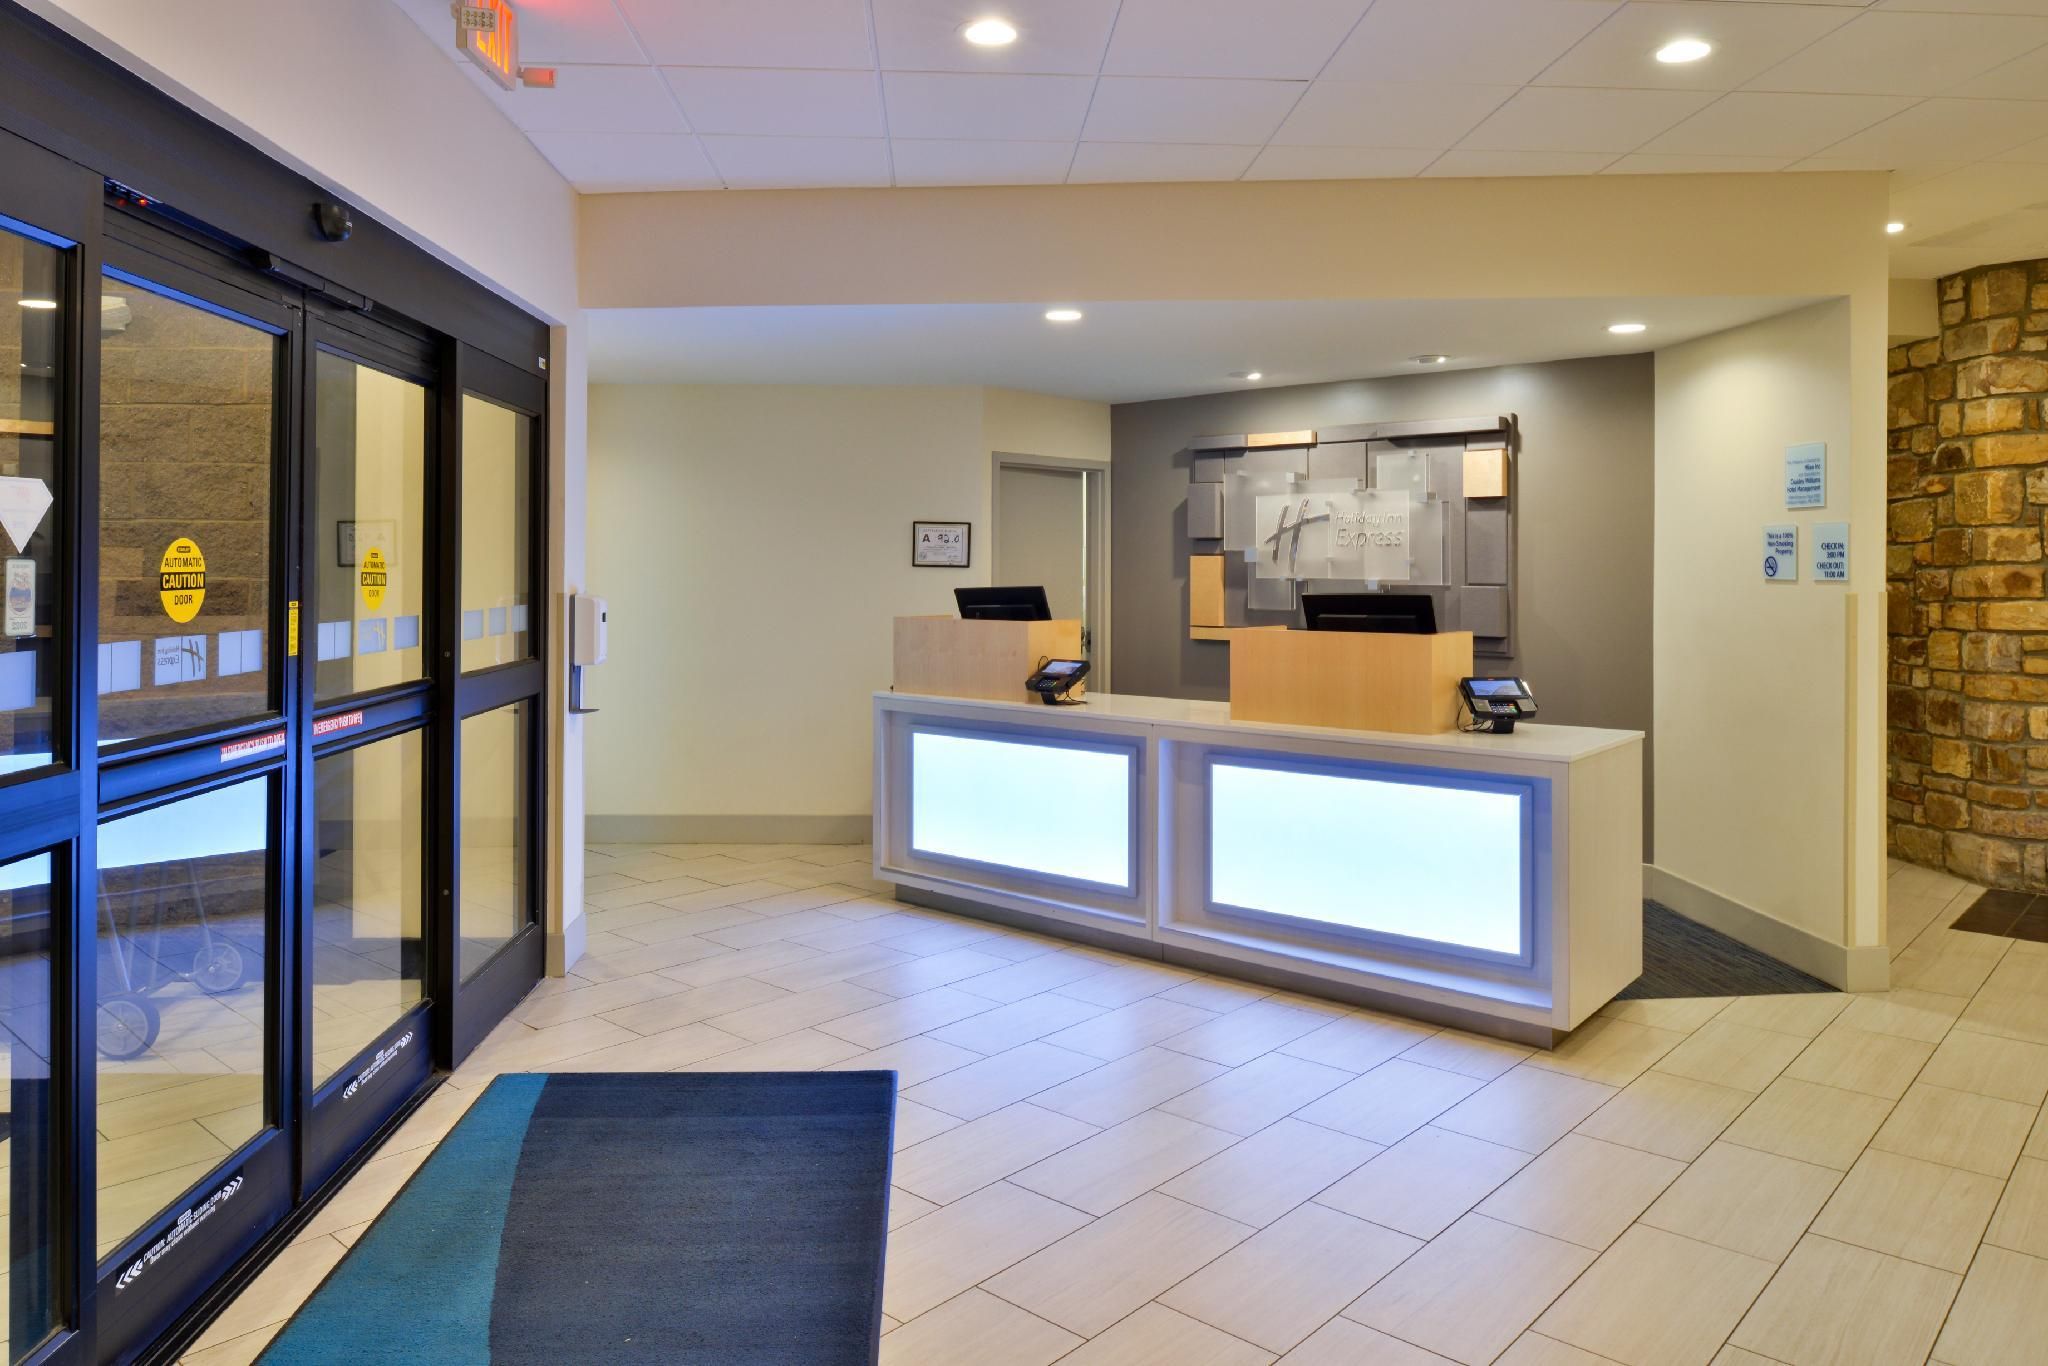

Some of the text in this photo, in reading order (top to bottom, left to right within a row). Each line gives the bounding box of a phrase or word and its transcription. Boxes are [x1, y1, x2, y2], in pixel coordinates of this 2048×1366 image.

[1336, 511, 1403, 527] Holiday Inn
[1336, 528, 1404, 549] Express
[164, 557, 202, 568] AUTOMATIC
[1816, 561, 1833, 570] CHECK
[162, 572, 204, 589] CAUTION
[362, 573, 386, 586] CAUTION
[174, 594, 193, 606] DOOR
